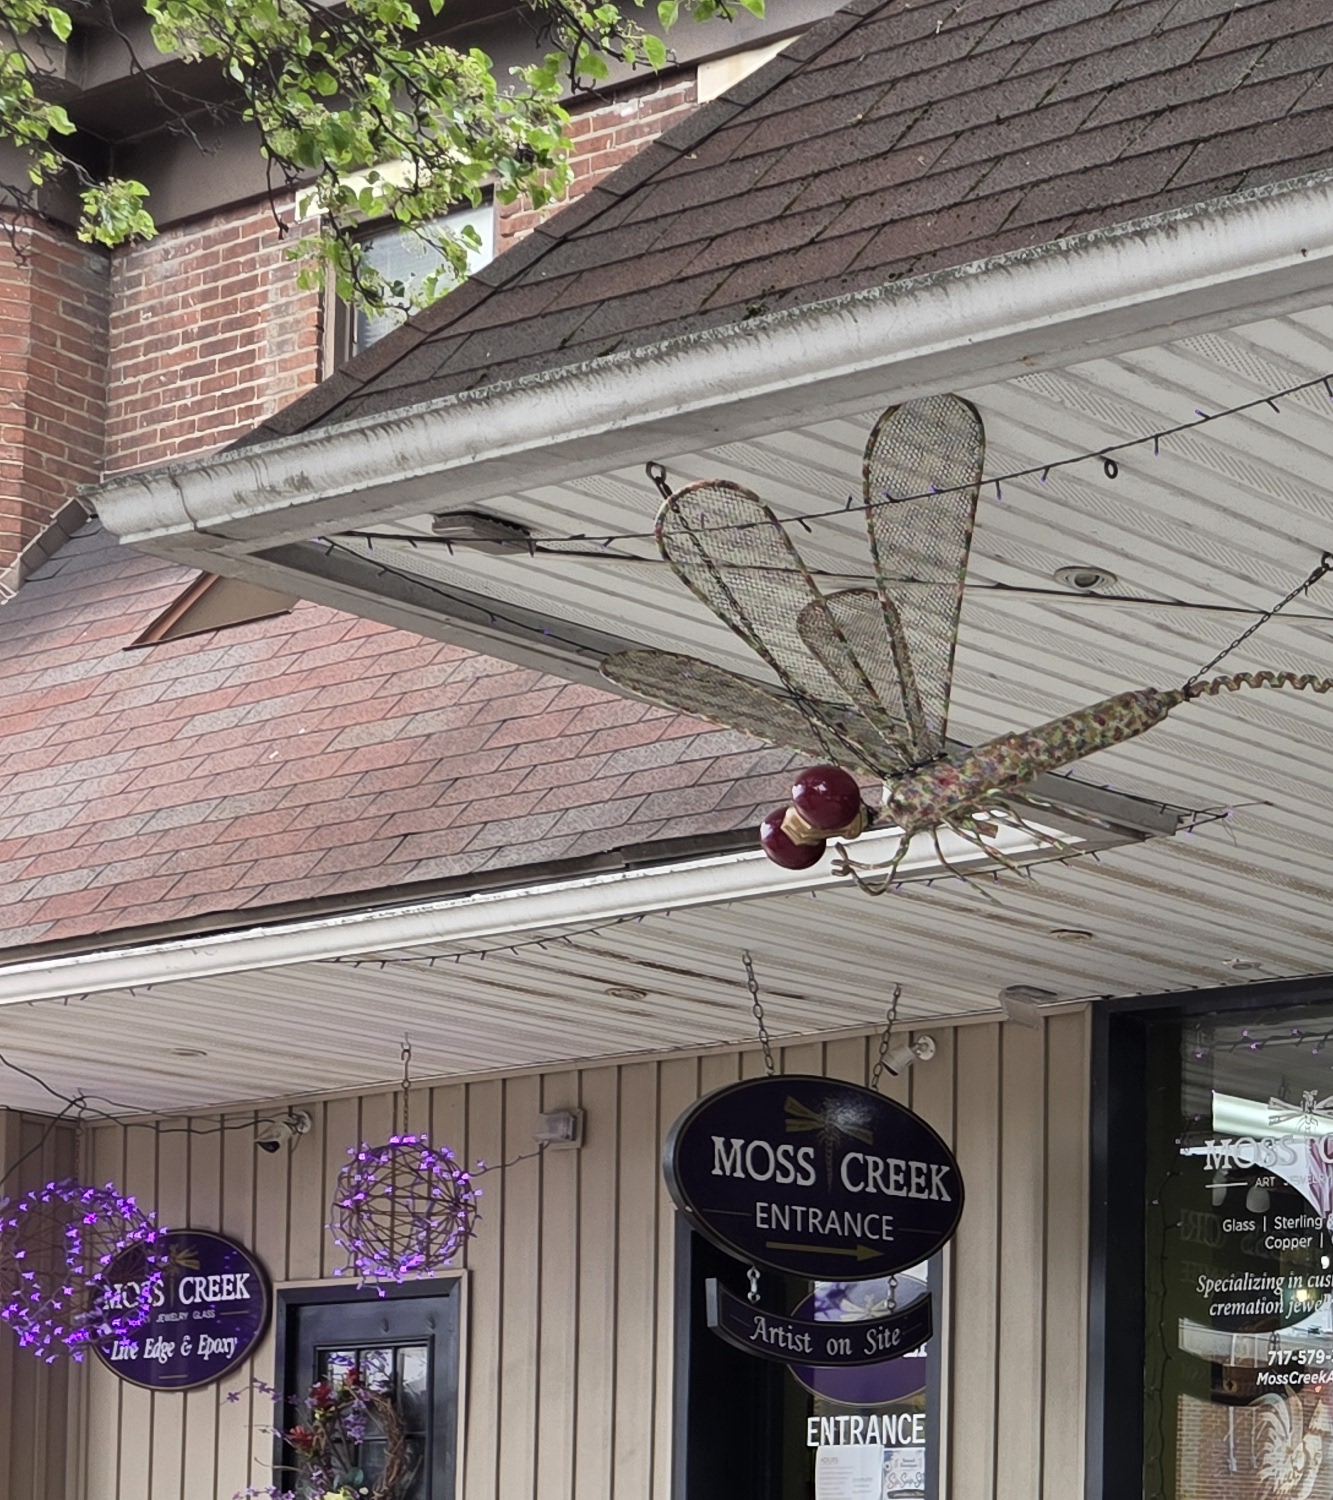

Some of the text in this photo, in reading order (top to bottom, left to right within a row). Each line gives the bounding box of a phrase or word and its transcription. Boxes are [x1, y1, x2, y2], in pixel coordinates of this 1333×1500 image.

[710, 1135, 952, 1202] MOSS CREEK
[1203, 1135, 1298, 1171] MOSS
[1254, 1176, 1276, 1188] ART
[755, 1202, 895, 1241] ENTRANCE
[1222, 1218, 1256, 1233] Glass
[1273, 1213, 1324, 1231] Sterling
[1264, 1234, 1313, 1251] Copper
[178, 1273, 251, 1305] CREEK
[1196, 1272, 1284, 1296] Specializing
[1287, 1271, 1303, 1289] in
[1209, 1295, 1284, 1317] cremation
[143, 1335, 176, 1364] Edge
[180, 1334, 193, 1356] &
[197, 1333, 238, 1360] Epoxy
[750, 1315, 813, 1354] Artist
[826, 1338, 852, 1355] on
[864, 1325, 901, 1355] Site
[806, 1413, 926, 1447] ENTRANCE
